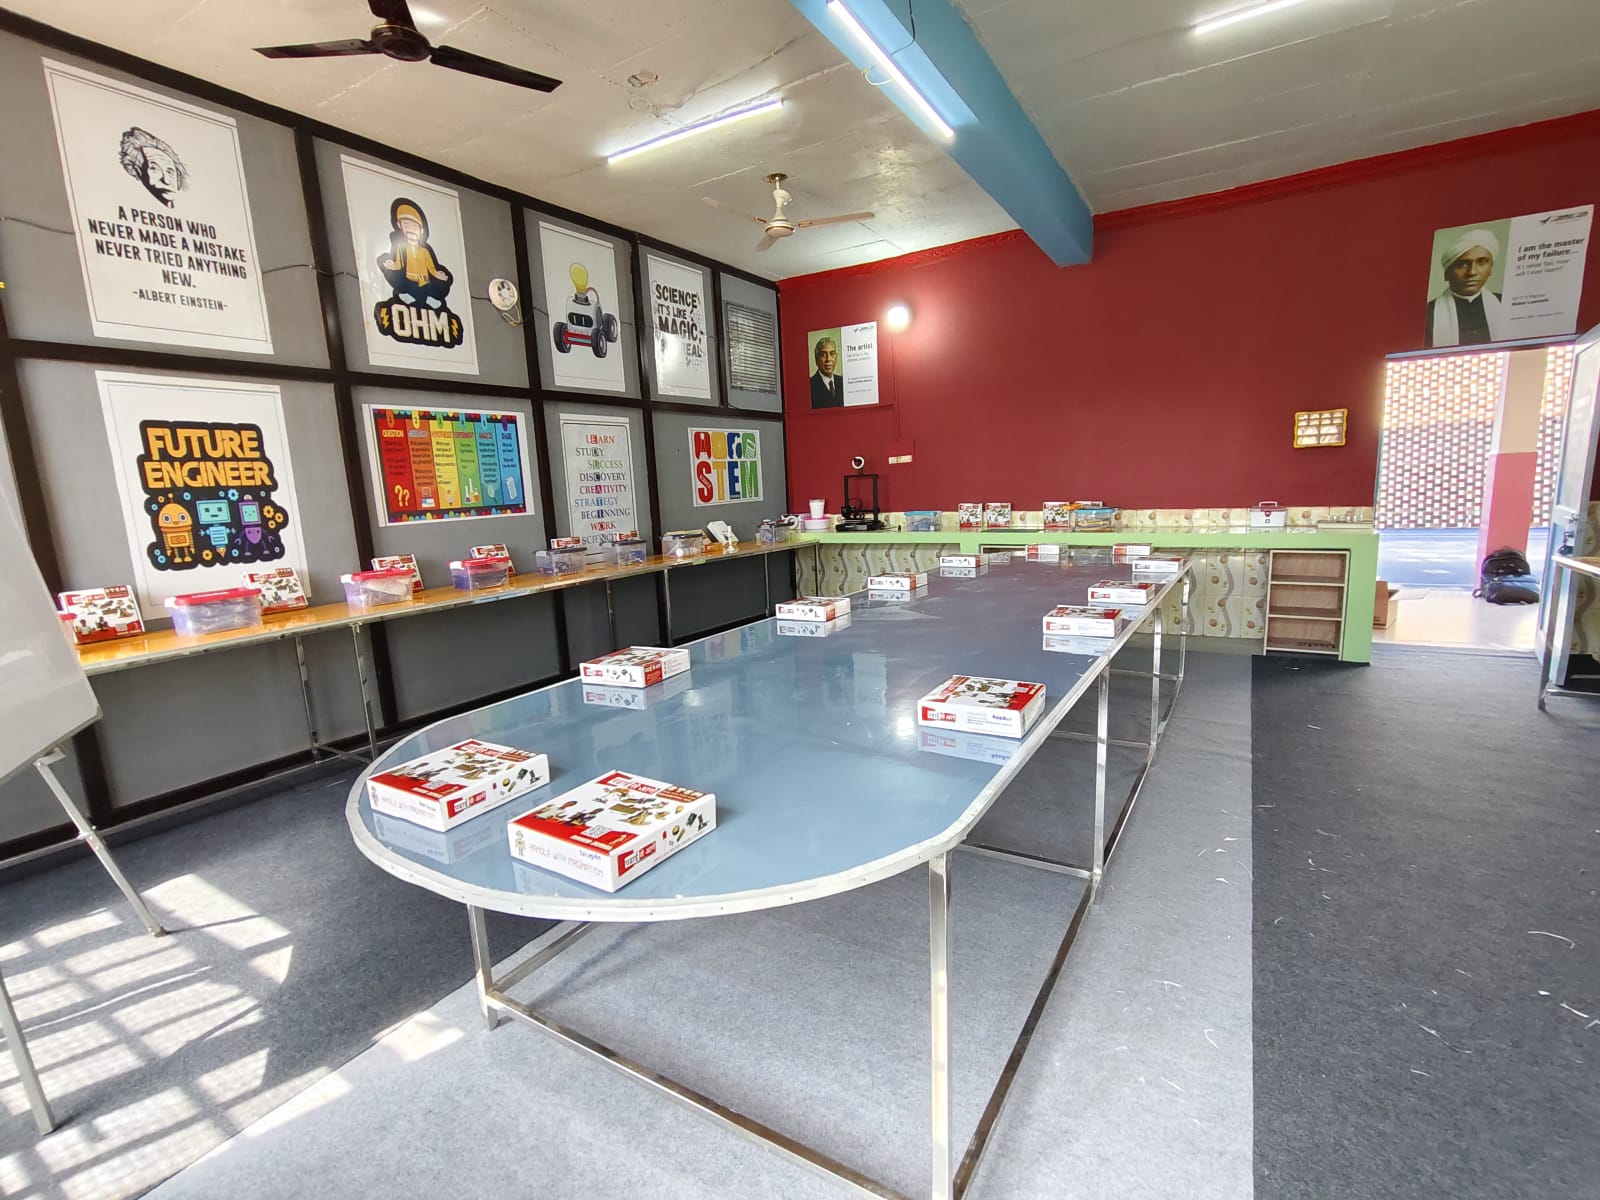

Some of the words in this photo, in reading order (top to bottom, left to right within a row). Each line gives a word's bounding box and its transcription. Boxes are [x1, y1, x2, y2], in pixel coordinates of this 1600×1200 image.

[118, 206, 128, 221] A
[131, 207, 183, 233] PERSON
[186, 220, 217, 240] WHO
[88, 218, 135, 241] NEVER
[139, 230, 177, 249] MADE
[181, 238, 189, 252] A
[194, 239, 247, 263] MISTAKE
[1554, 238, 1585, 248] master
[95, 239, 141, 261] NEVER
[147, 248, 183, 268] TRIED
[187, 256, 247, 279] ANYTHING
[1517, 254, 1526, 262] of
[1528, 253, 1541, 261] my
[162, 269, 197, 289] NEW.
[657, 304, 671, 316] IT'S
[672, 306, 687, 319] LIKE
[391, 303, 451, 343] OHM
[146, 427, 261, 460] FUTURE
[585, 434, 615, 445] LEARN
[575, 447, 604, 457] STUDY
[587, 460, 623, 470] SUCCESS
[143, 460, 272, 489] ENGINEER
[579, 471, 626, 482] DISCOVERY
[696, 460, 759, 503] STEM
[579, 484, 627, 495] CREATIVITY
[574, 496, 619, 508] STRATEGY
[581, 508, 631, 520] BEGINNING
[590, 520, 616, 531] WORK
